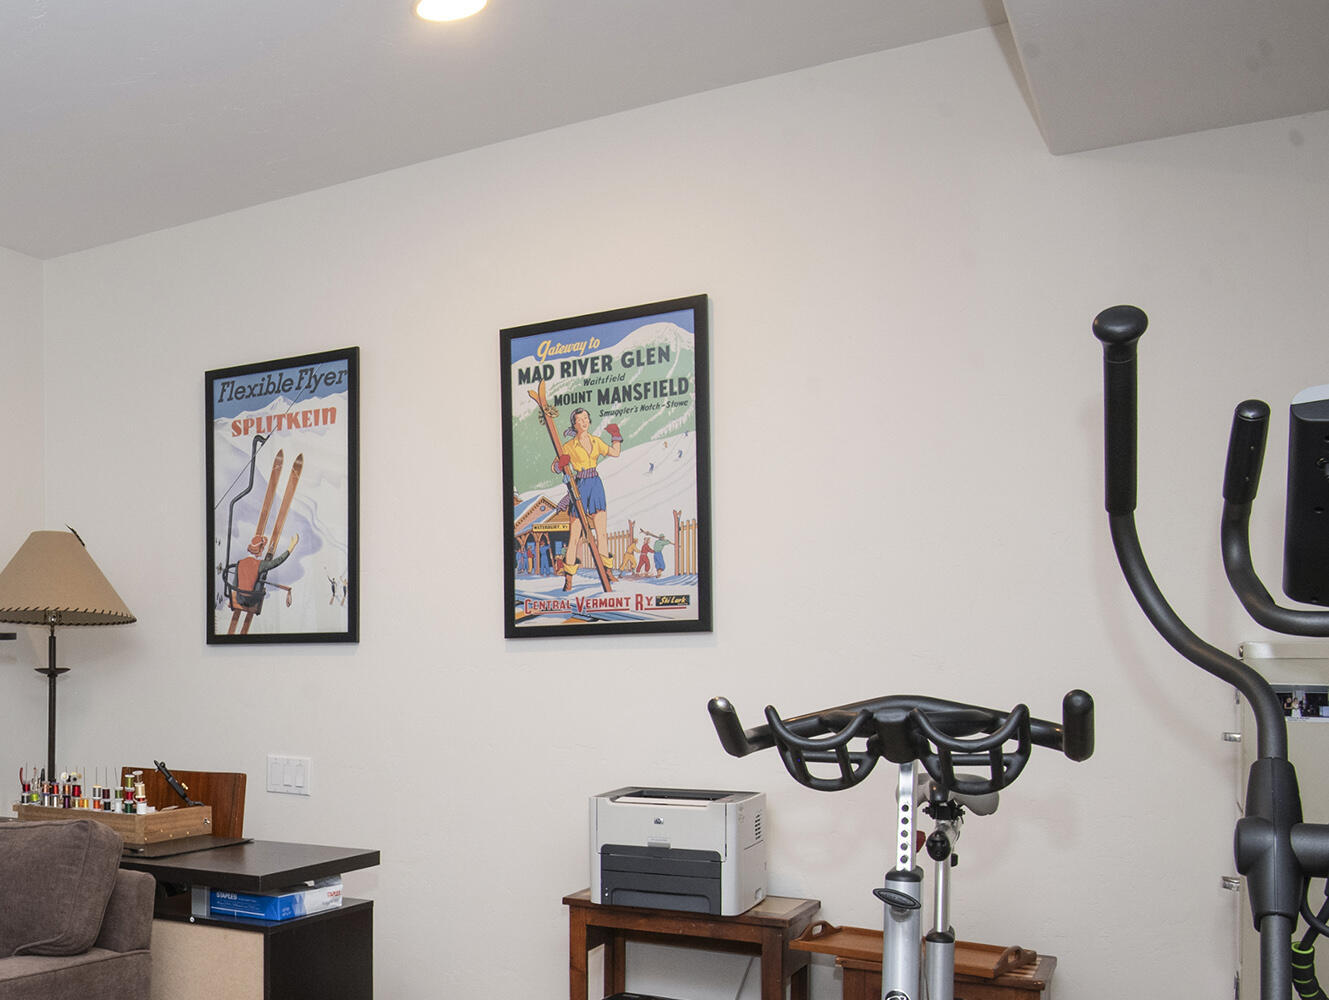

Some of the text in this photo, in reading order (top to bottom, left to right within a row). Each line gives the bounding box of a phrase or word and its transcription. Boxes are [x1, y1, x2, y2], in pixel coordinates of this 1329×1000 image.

[588, 336, 601, 350] to
[518, 345, 670, 386] MAD RIVER GLEN
[583, 373, 626, 387] Waitsfield
[217, 367, 348, 403] Flexible Flyer
[554, 376, 689, 407] MOUNT MANSFIELD
[231, 406, 337, 437] SPLITKEIN
[524, 598, 572, 615] CENTRAL
[575, 596, 631, 613] VERMONT
